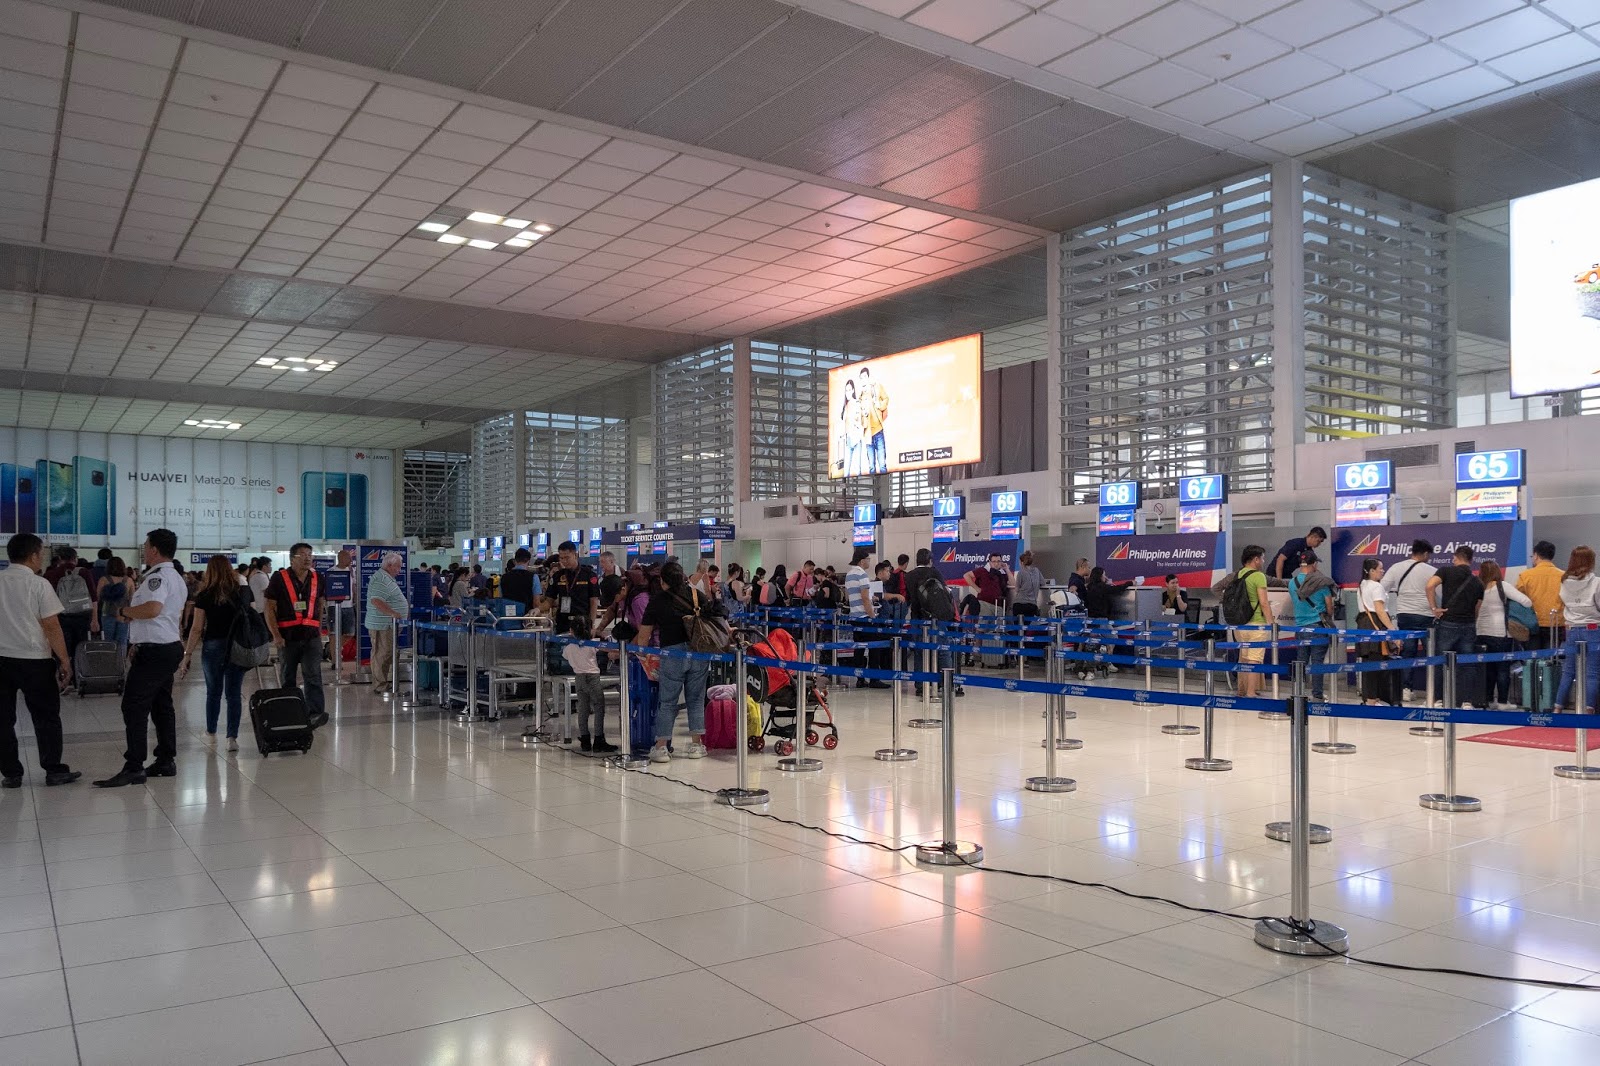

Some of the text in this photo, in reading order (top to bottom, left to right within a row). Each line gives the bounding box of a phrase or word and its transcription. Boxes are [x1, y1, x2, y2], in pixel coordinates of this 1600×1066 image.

[1468, 452, 1508, 479] 65
[128, 471, 188, 483] HUAWEI
[241, 477, 271, 487] Series
[1345, 464, 1379, 488] 66
[1106, 484, 1129, 504] 68
[1187, 478, 1214, 499] 67
[938, 498, 956, 516] 70
[997, 493, 1016, 511] 69
[144, 507, 192, 517] HIGHER
[203, 508, 287, 520] INTELLIGENCE
[857, 506, 871, 521] 71
[635, 534, 652, 542] SERVICE
[653, 532, 674, 541] COUNTER
[1128, 548, 1206, 561] Philippine Airlines
[1379, 541, 1496, 557] Philipe Aiines
[192, 554, 199, 562] B
[955, 553, 985, 564] Philippine
